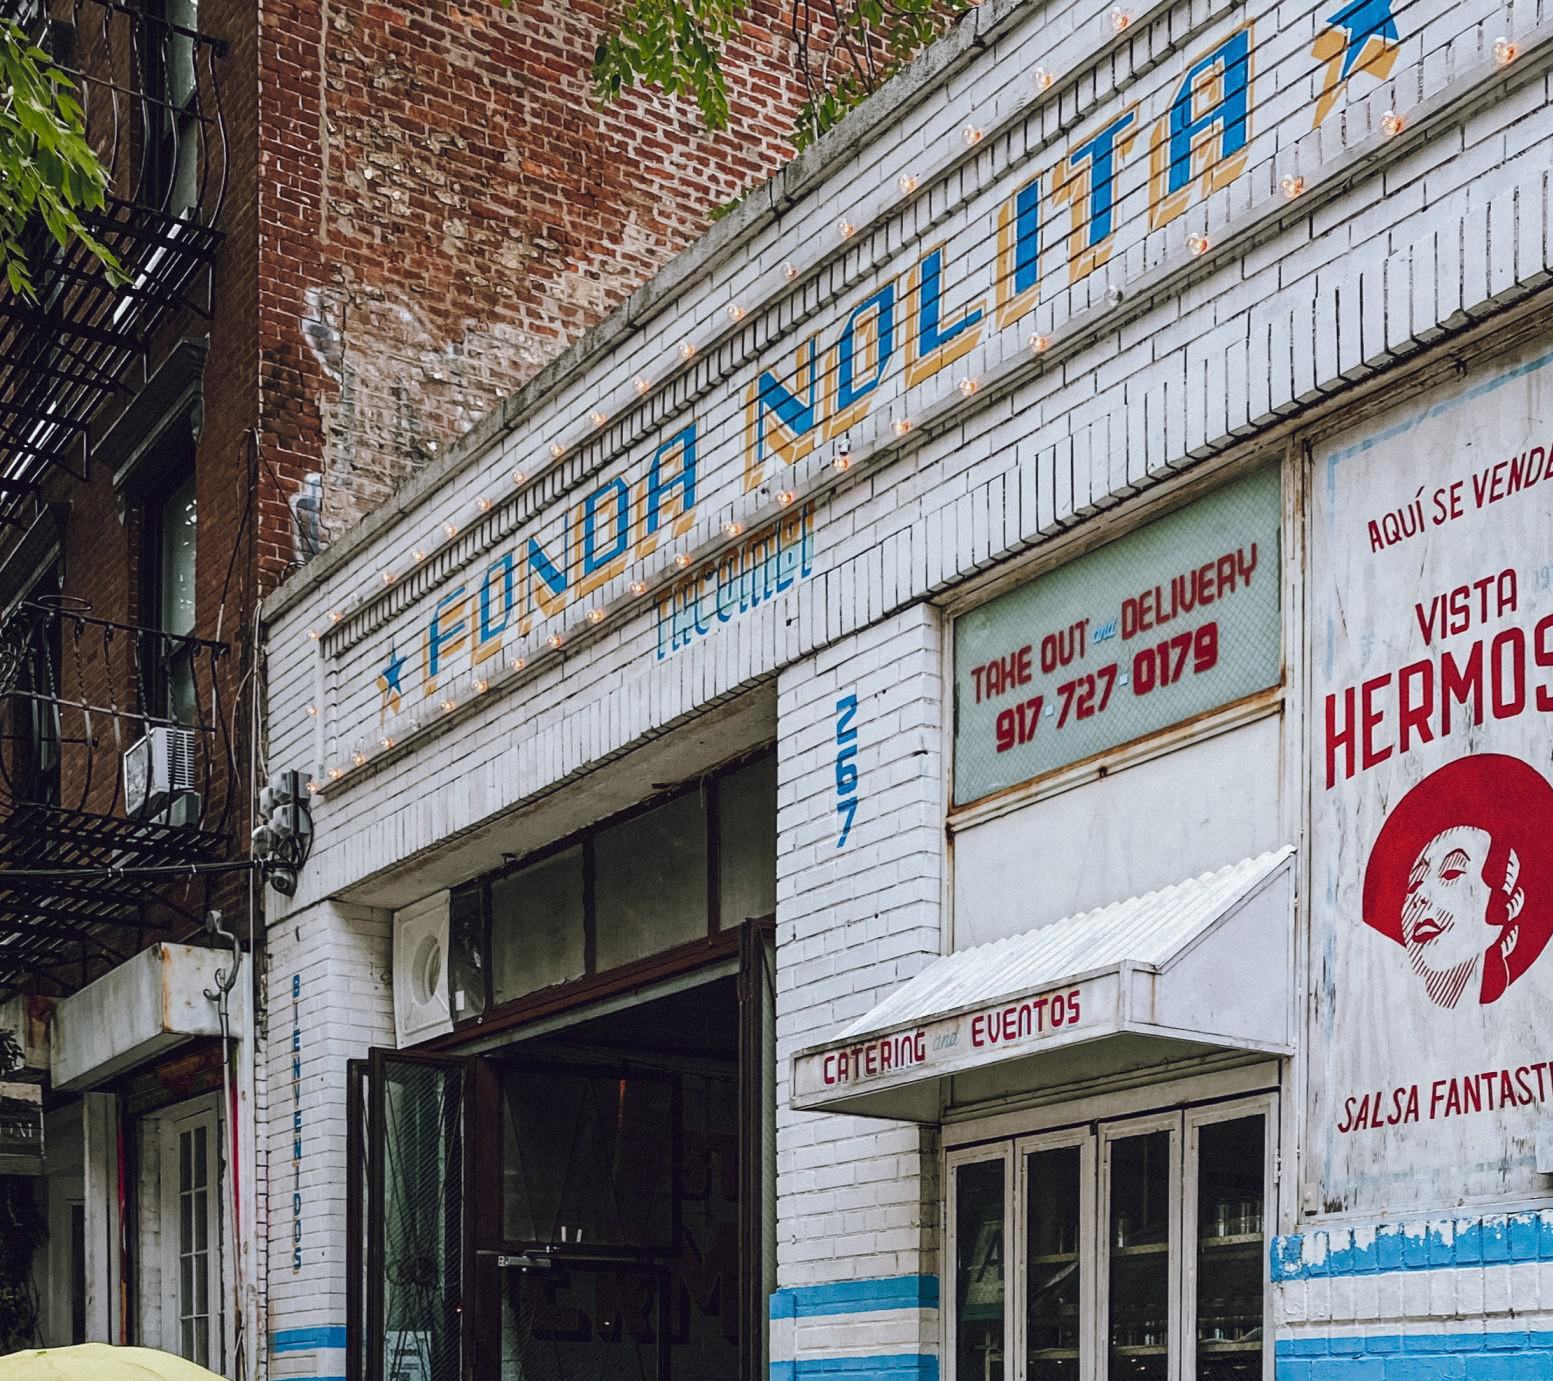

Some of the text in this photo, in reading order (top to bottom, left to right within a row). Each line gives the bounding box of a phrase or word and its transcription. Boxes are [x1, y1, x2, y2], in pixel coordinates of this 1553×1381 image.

[423, 16, 1255, 698] FONDA NOLITA
[1367, 485, 1425, 553] AQUÍ
[1432, 479, 1464, 526] SE
[971, 542, 1258, 704] TAKE OUT and DELIVERY
[1415, 568, 1517, 647] VISTA
[835, 694, 858, 848] 267
[823, 989, 1081, 1085] CATERING and EVENTOS
[1337, 1085, 1419, 1134] SALSA
